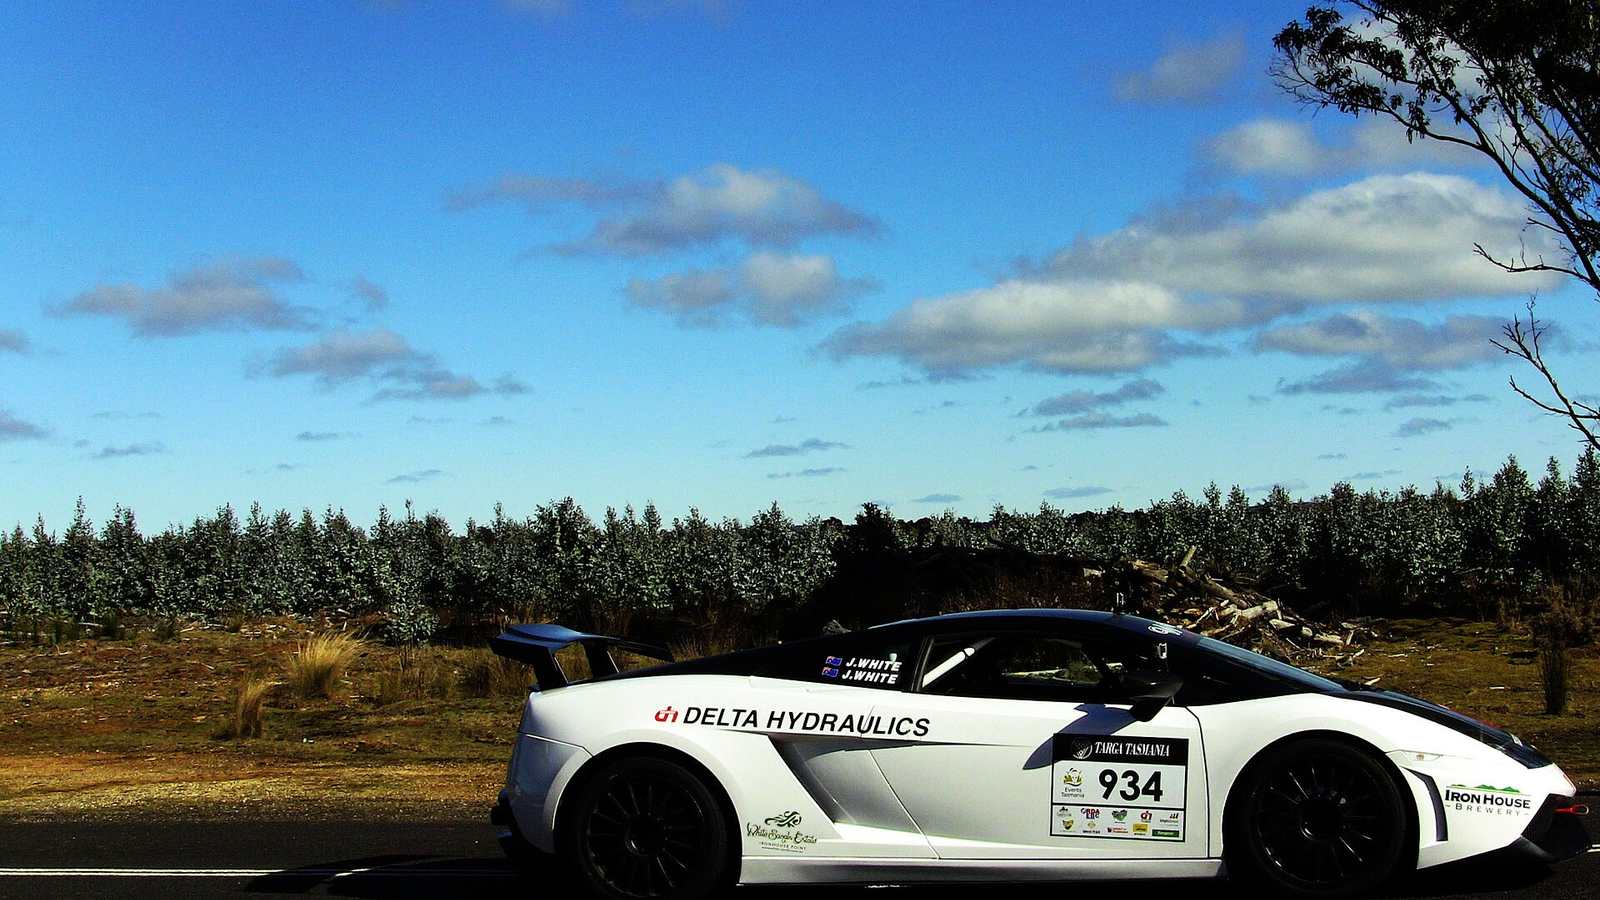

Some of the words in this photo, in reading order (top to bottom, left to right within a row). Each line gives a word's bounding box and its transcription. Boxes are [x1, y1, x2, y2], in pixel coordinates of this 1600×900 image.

[846, 657, 902, 672] J.WHITE
[841, 669, 899, 685] J.WHITE
[683, 706, 758, 728] DELTA
[766, 711, 931, 737] HYDRAULICS
[1094, 741, 1123, 755] TARGA
[1125, 743, 1170, 757] TASMANIA
[1098, 769, 1163, 802] 934
[1455, 802, 1520, 817] BREWERY
